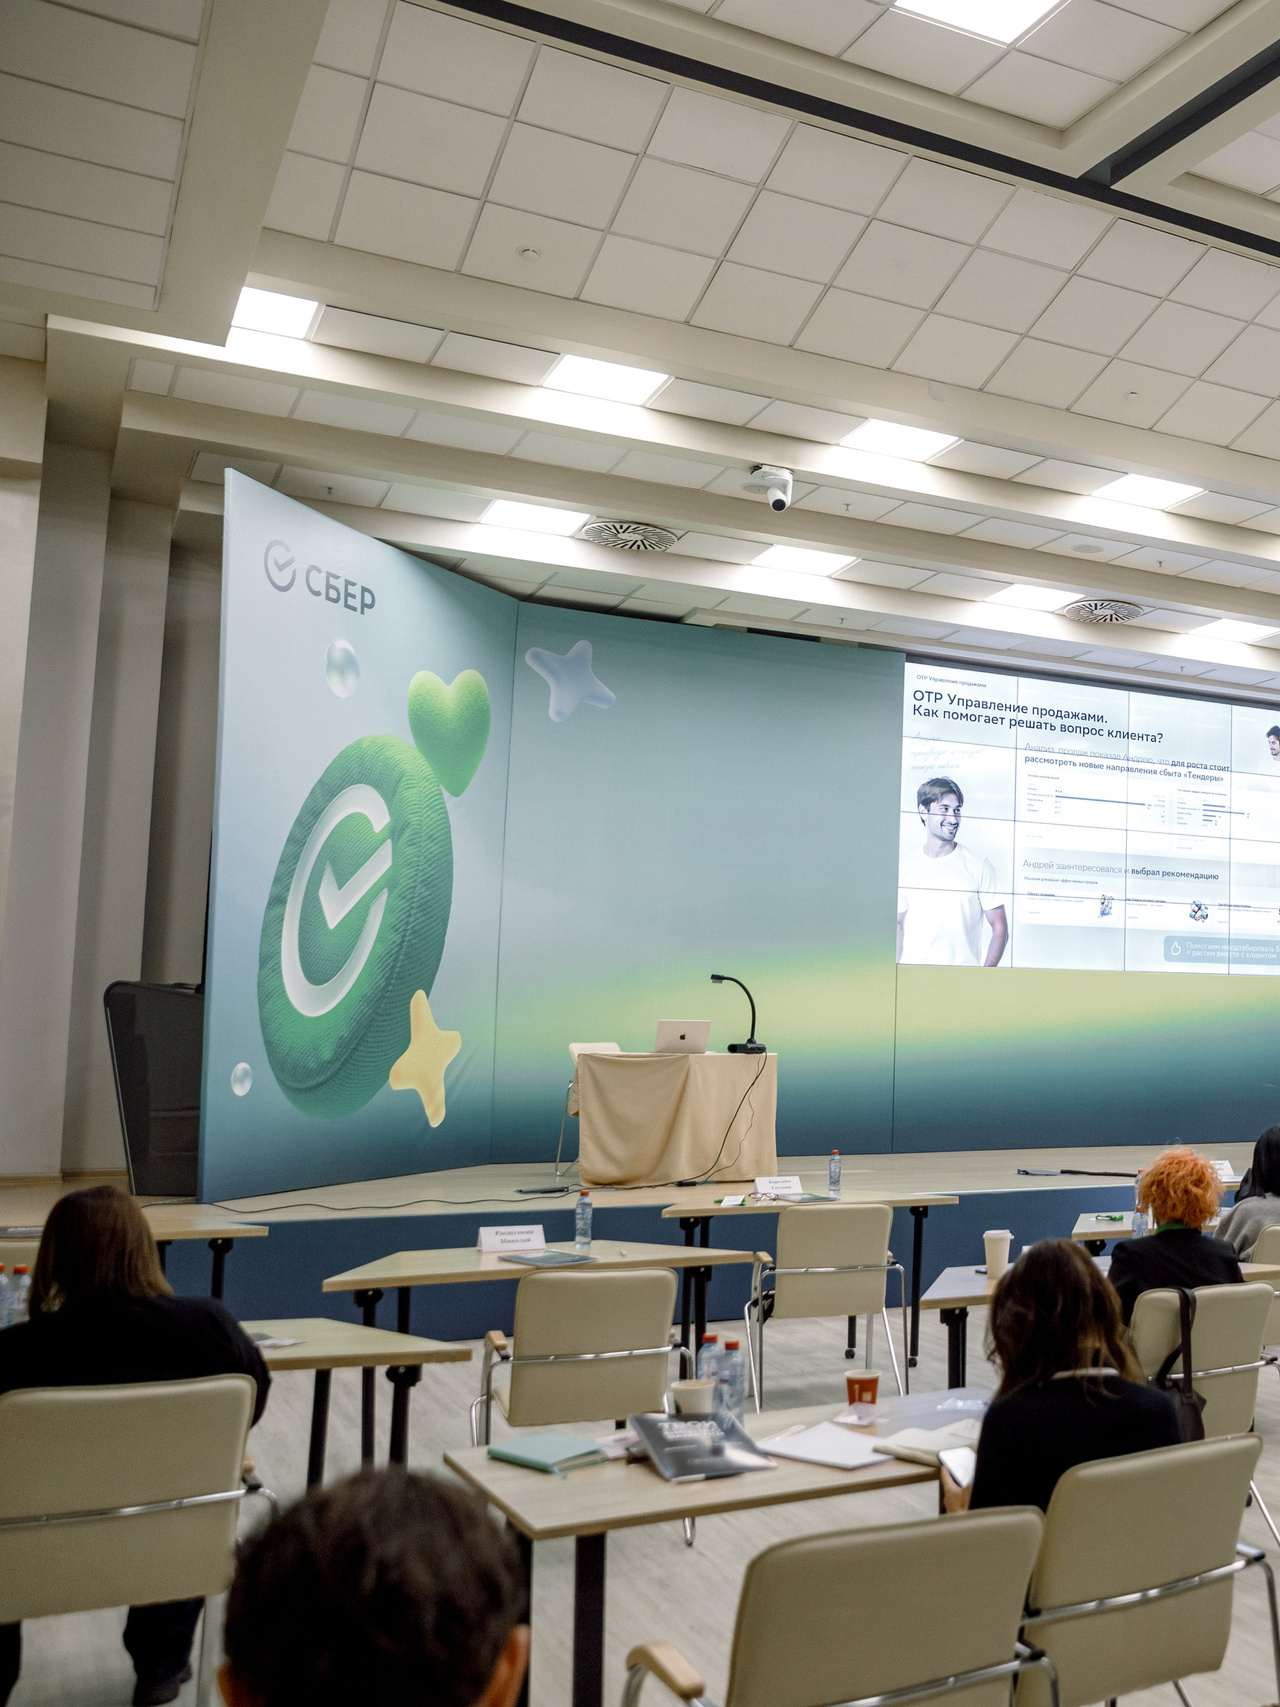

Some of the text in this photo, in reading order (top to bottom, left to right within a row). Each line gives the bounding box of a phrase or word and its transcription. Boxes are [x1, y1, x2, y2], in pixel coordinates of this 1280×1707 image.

[305, 563, 376, 615] СБЕР
[929, 676, 958, 686] Управление
[959, 680, 987, 688] продажами
[913, 689, 1108, 724] ОТР Управление продажами.
[913, 704, 1164, 744] Как помогает решать вопрос клиента?
[1024, 755, 1225, 783] рассмотреть новые направления сбыта «Тендеры»
[1170, 760, 1185, 769] для
[1186, 762, 1208, 772] роста
[1023, 859, 1054, 871] Андрей
[1055, 863, 1122, 875] заинтересовался
[1131, 866, 1160, 878] выбрал
[1161, 869, 1220, 882] рекомендацию
[1186, 942, 1220, 951] Помогаем
